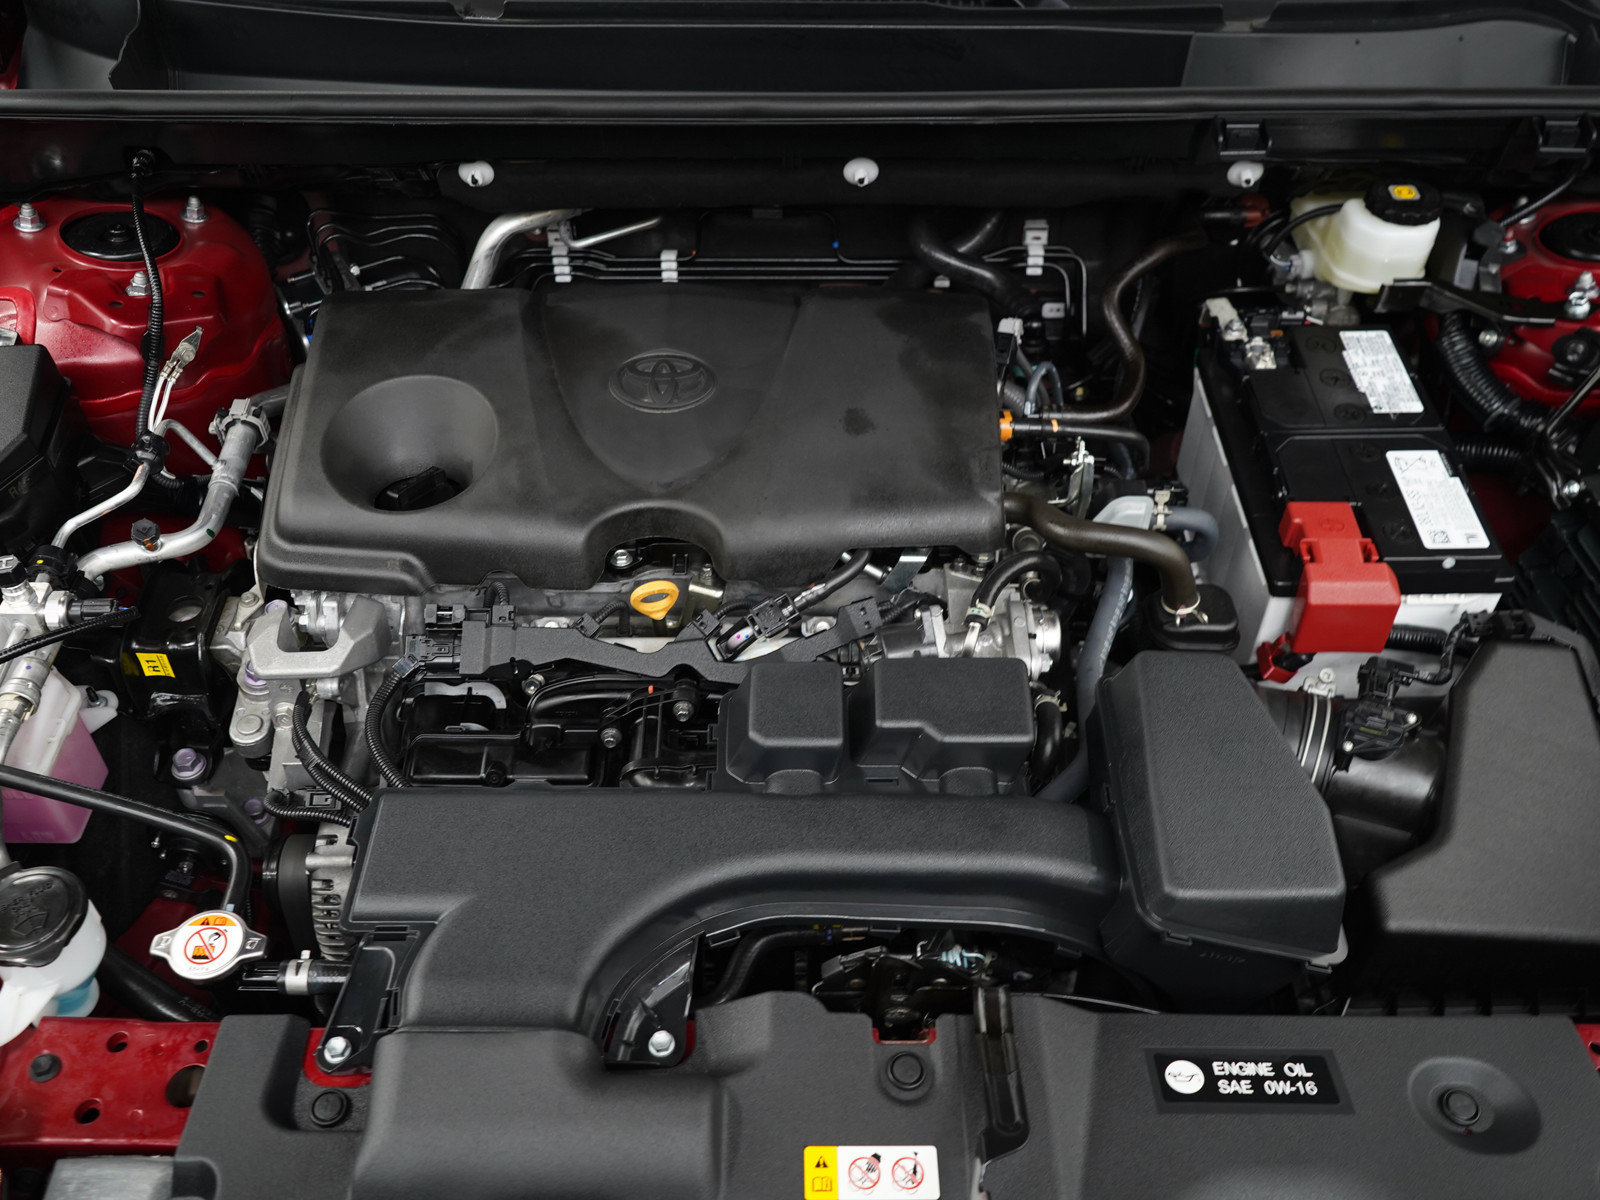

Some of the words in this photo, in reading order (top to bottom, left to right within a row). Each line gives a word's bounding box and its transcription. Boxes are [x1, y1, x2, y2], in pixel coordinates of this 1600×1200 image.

[1211, 1061, 1275, 1077] ENGINE
[1283, 1062, 1314, 1078] OIL
[1217, 1079, 1254, 1095] SAE
[1263, 1079, 1319, 1096] 0W-16
